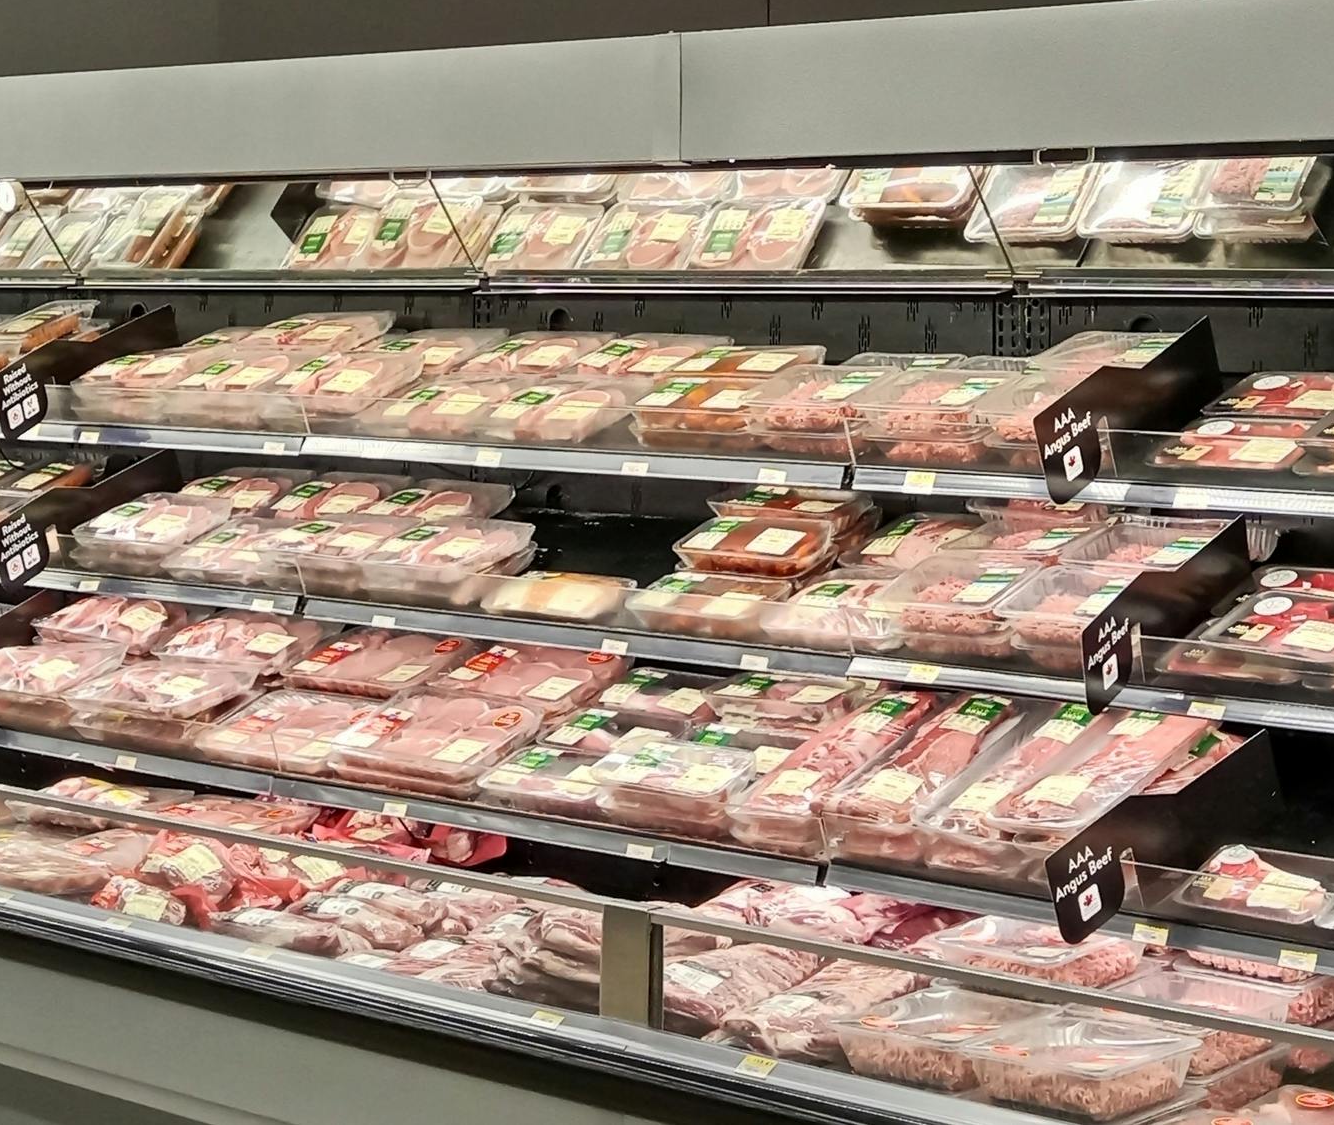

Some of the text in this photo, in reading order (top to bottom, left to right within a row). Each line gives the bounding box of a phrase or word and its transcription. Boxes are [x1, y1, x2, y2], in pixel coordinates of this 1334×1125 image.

[2, 374, 32, 397] Without
[3, 363, 27, 385] Raised
[1, 382, 39, 411] Antibiotics
[1053, 407, 1076, 433] AAA
[1044, 411, 1092, 460] Angus Beef
[1, 524, 32, 548] Without
[2, 513, 27, 536] Raised
[0, 532, 39, 562] Antibiotics
[1098, 616, 1117, 643] AAA
[1087, 617, 1129, 671] Angus Beef
[1068, 845, 1094, 874] AAA
[1055, 846, 1113, 903] Angus Beef
